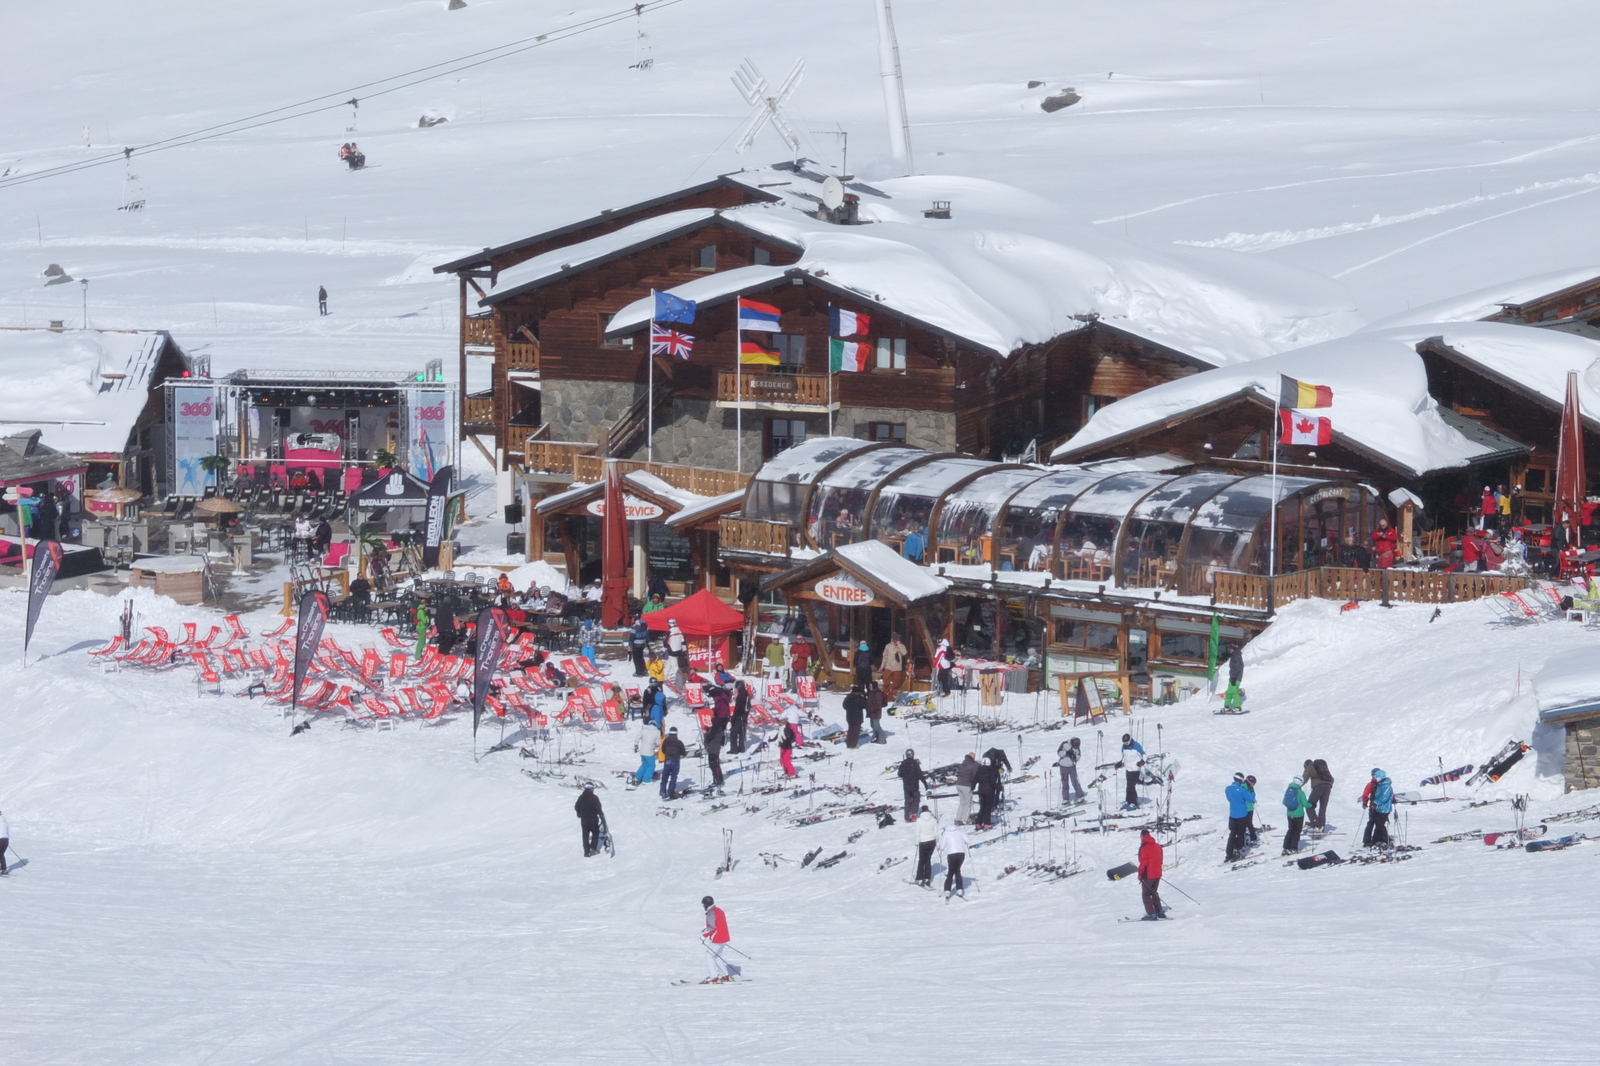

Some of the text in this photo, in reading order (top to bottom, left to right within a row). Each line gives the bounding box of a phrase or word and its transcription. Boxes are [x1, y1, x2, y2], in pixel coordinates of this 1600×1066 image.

[750, 380, 791, 389] RESIDENCE
[427, 496, 440, 546] BATALEON
[624, 505, 655, 516] ERVICE
[34, 560, 54, 594] Thorens
[823, 585, 867, 602] ENTREE
[302, 612, 322, 650] Thorens
[480, 630, 500, 671] Thorens
[689, 650, 722, 662] AFFLE
